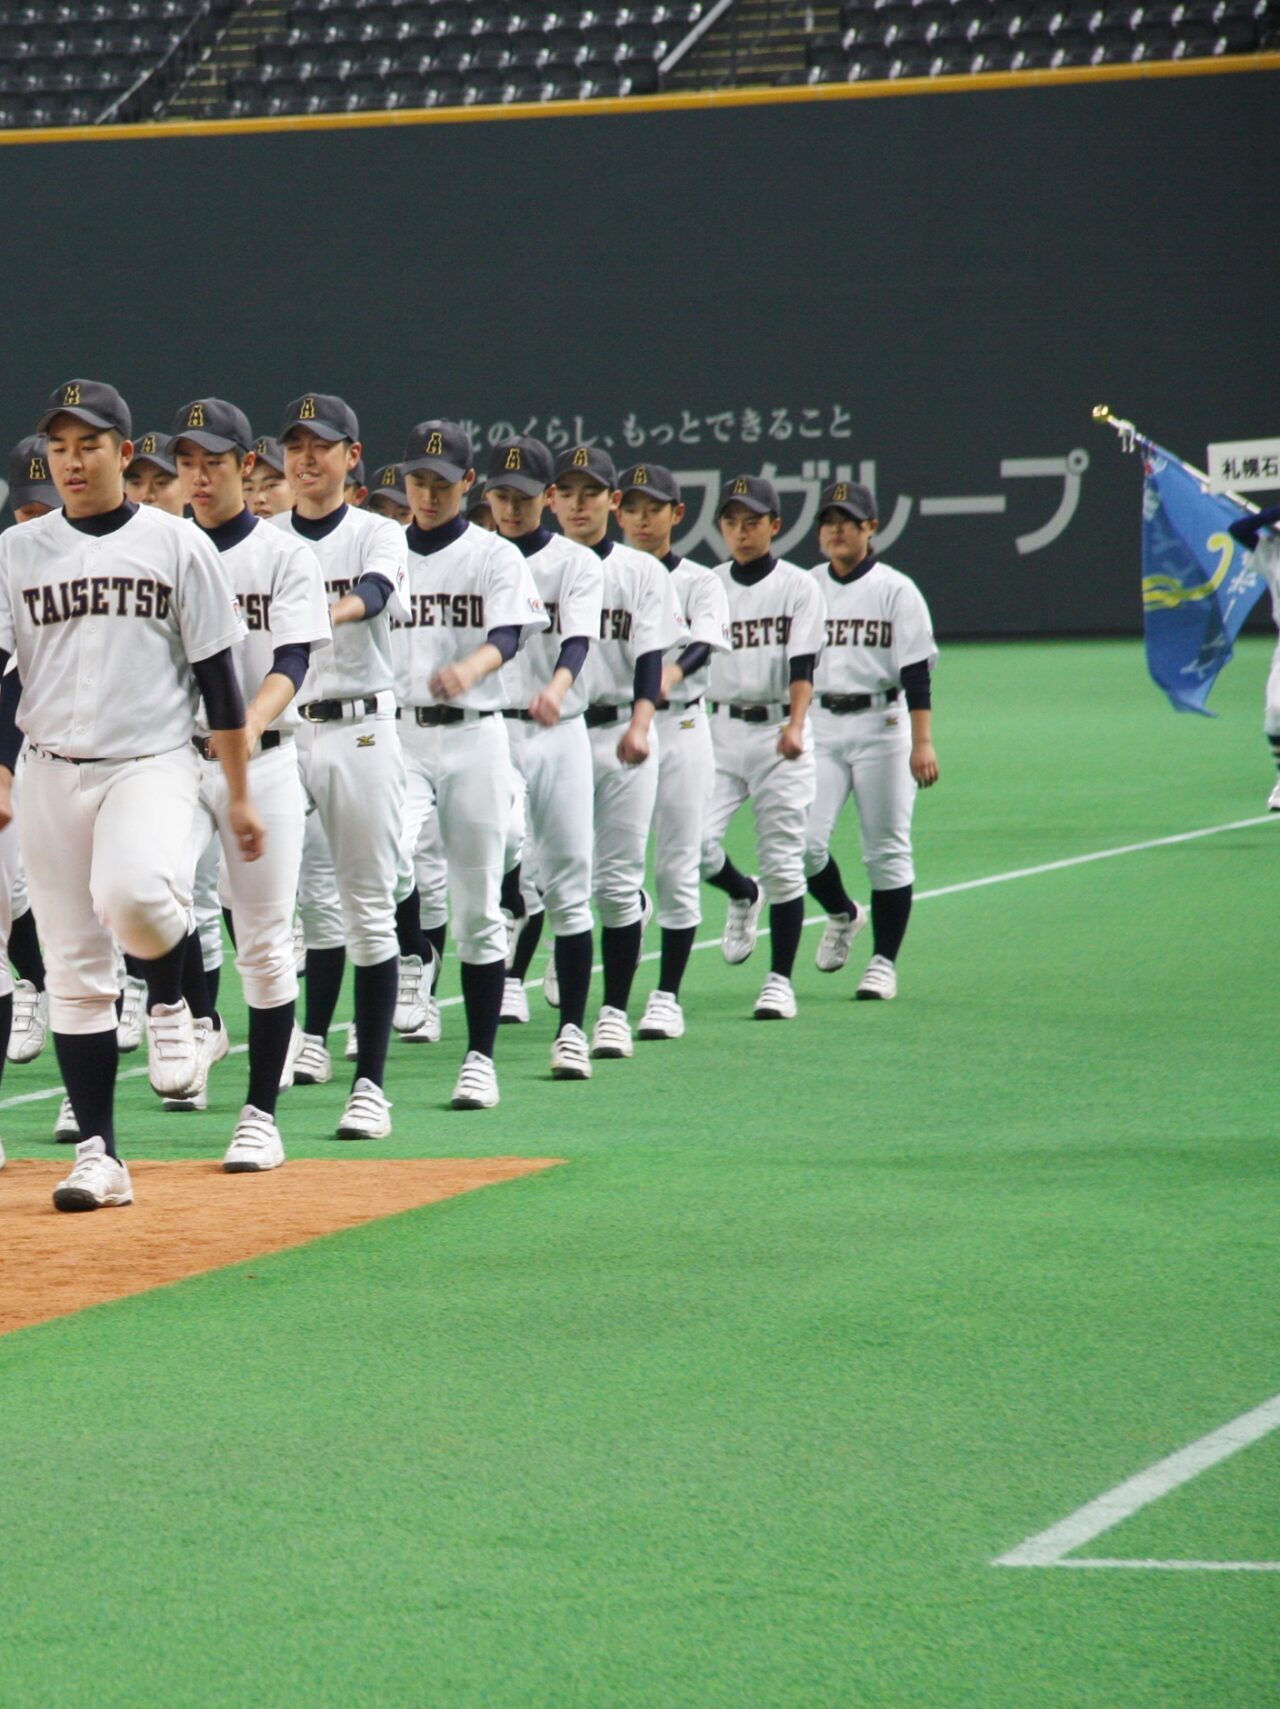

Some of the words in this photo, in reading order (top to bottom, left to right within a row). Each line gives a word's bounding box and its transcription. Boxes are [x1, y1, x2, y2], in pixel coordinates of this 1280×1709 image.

[188, 404, 204, 427] A
[299, 398, 315, 420] A
[426, 432, 442, 455] A
[30, 457, 46, 480] A
[505, 449, 520, 470] A
[573, 448, 588, 467] A
[633, 465, 647, 484] A
[22, 576, 173, 627] TAISETSU
